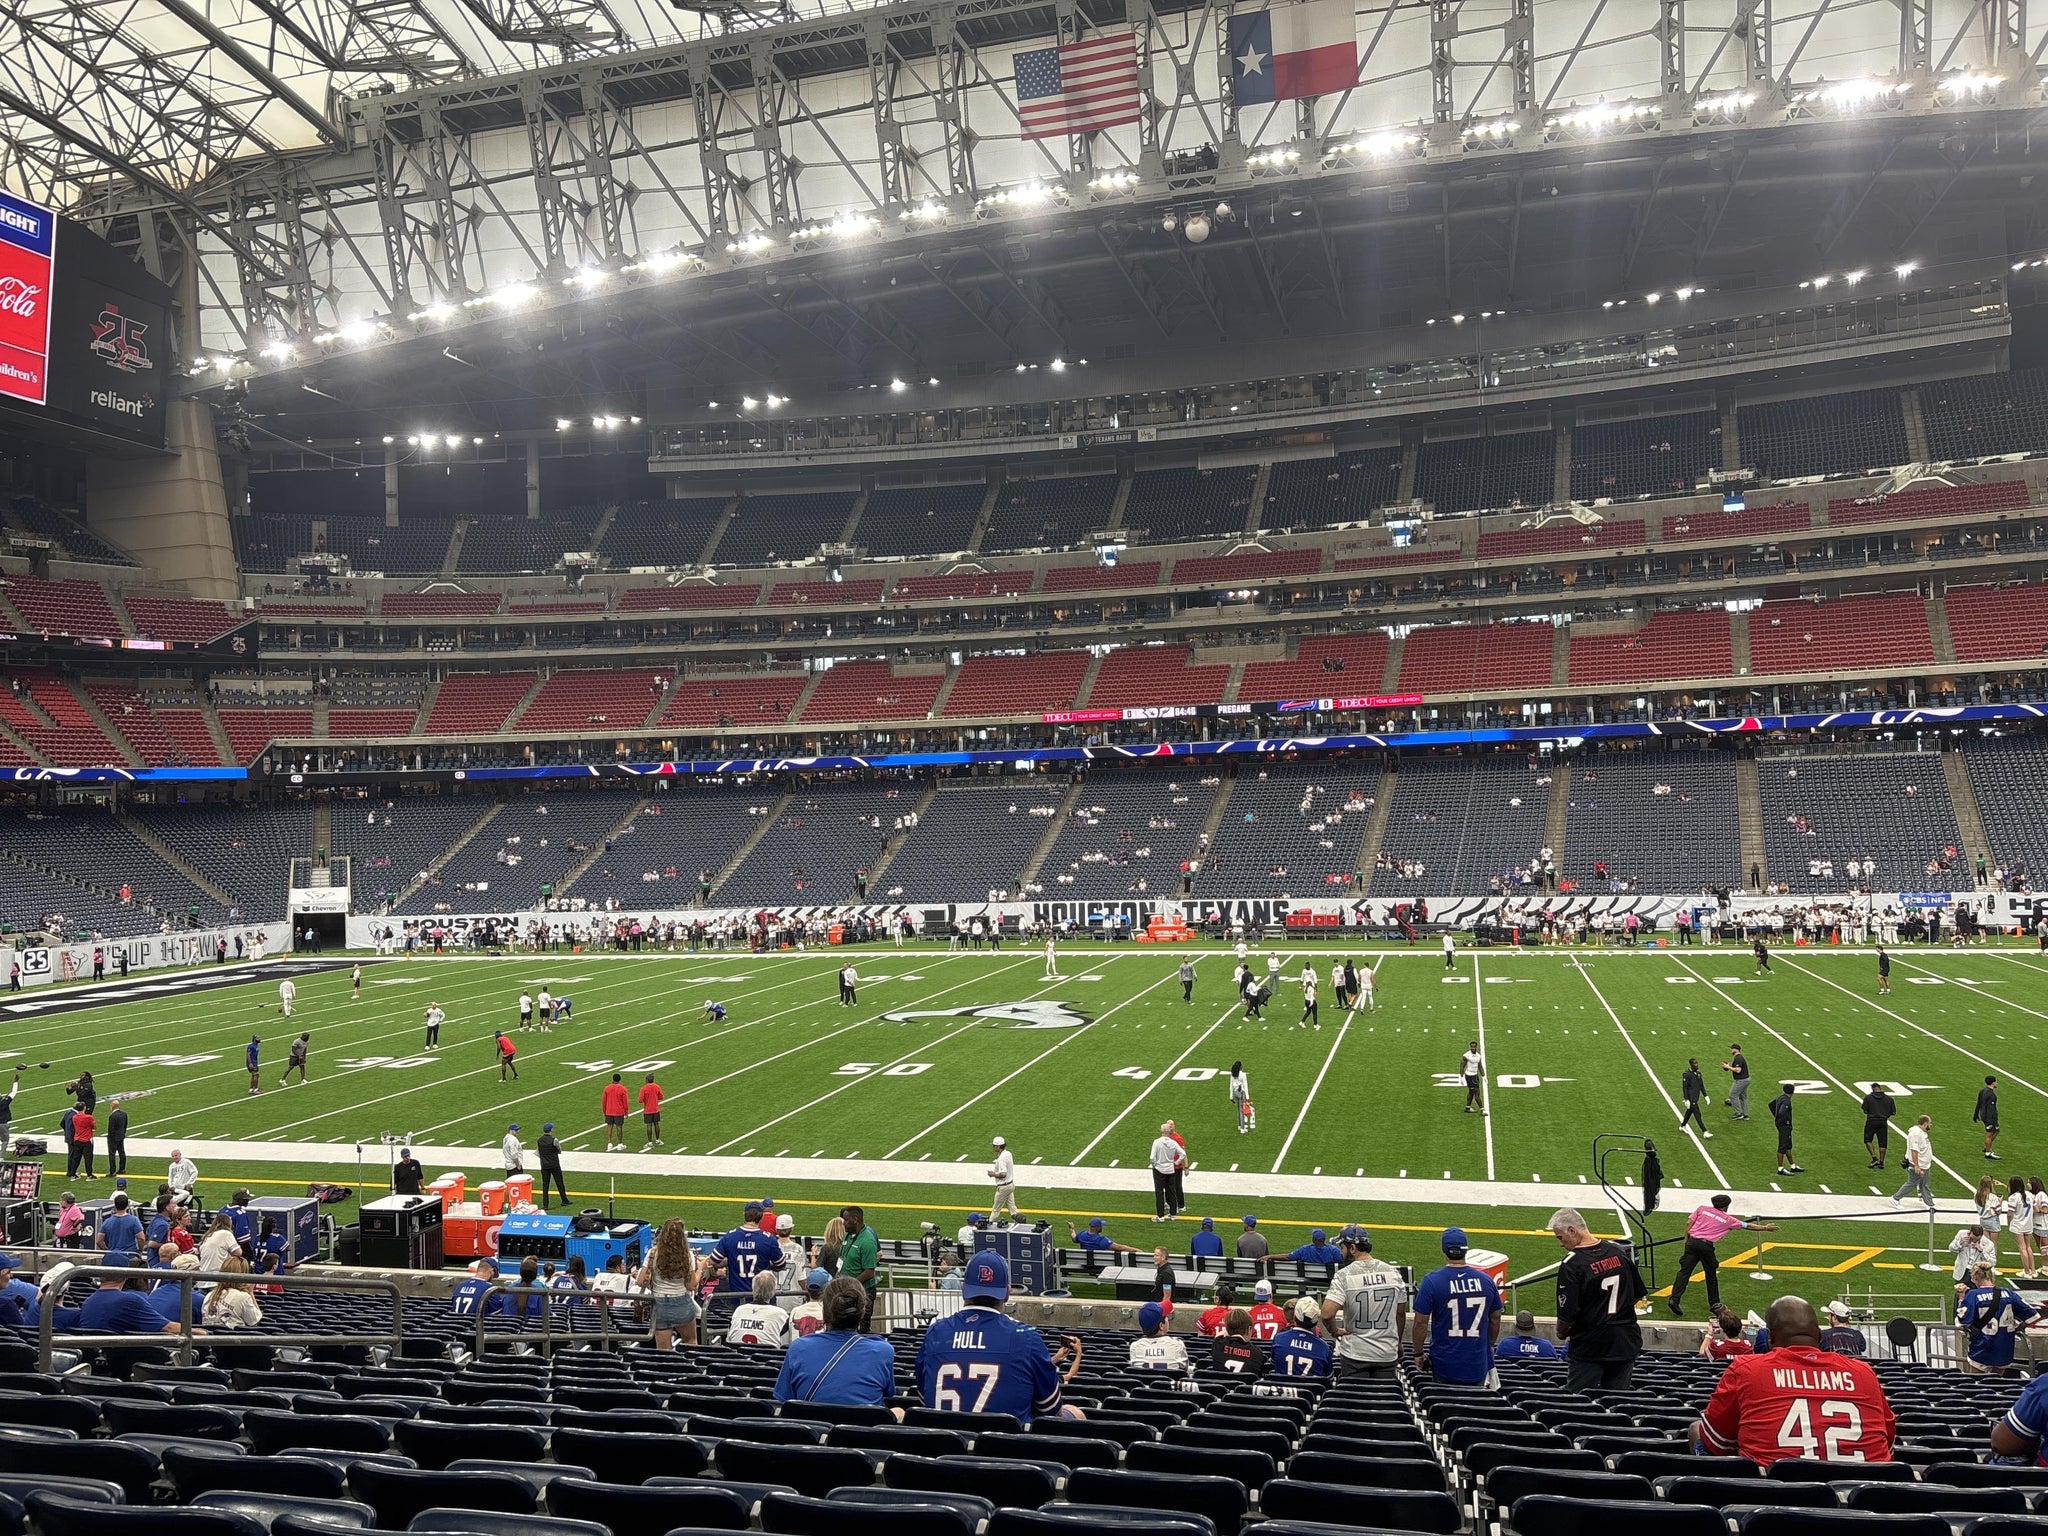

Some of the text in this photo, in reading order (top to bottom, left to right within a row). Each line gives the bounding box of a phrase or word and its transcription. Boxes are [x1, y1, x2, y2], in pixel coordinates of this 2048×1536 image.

[97, 311, 148, 368] 25
[91, 390, 143, 417] reliant
[1217, 704, 1252, 715] PREGAME
[1341, 698, 1372, 708] TDECU
[1045, 713, 1074, 723] TDECU
[403, 917, 518, 929] HOUSTON
[26, 951, 49, 971] 25
[129, 941, 151, 966] UP
[576, 1061, 677, 1072] 40
[831, 1063, 936, 1075] 50
[1111, 1066, 1219, 1081] 40
[481, 1192, 490, 1203] G
[510, 1186, 520, 1198] G
[737, 1241, 756, 1249] ALLEN
[736, 1254, 758, 1278] 17
[1590, 1255, 1621, 1276] STROUD
[558, 1281, 572, 1289] ALLEN
[1363, 1273, 1387, 1286] ALLEN
[1449, 1278, 1482, 1294] ALLEN
[460, 1286, 477, 1294] ALLEN
[1601, 1274, 1621, 1315] 7
[455, 1296, 474, 1314] 17
[1355, 1288, 1396, 1330] 17
[1256, 1313, 1274, 1321] ALLEN
[1447, 1296, 1487, 1338] 17
[1254, 1322, 1279, 1340] 17
[952, 1331, 986, 1350] HULL
[1290, 1338, 1313, 1351] ALLEN
[1520, 1343, 1539, 1353] COOK
[1144, 1348, 1165, 1357] ALLEN
[1223, 1345, 1251, 1358] STROUD
[1285, 1354, 1313, 1376] 17
[1772, 1367, 1856, 1392] WILLIAMS
[934, 1363, 1000, 1412] 67
[1777, 1397, 1866, 1463] 42
